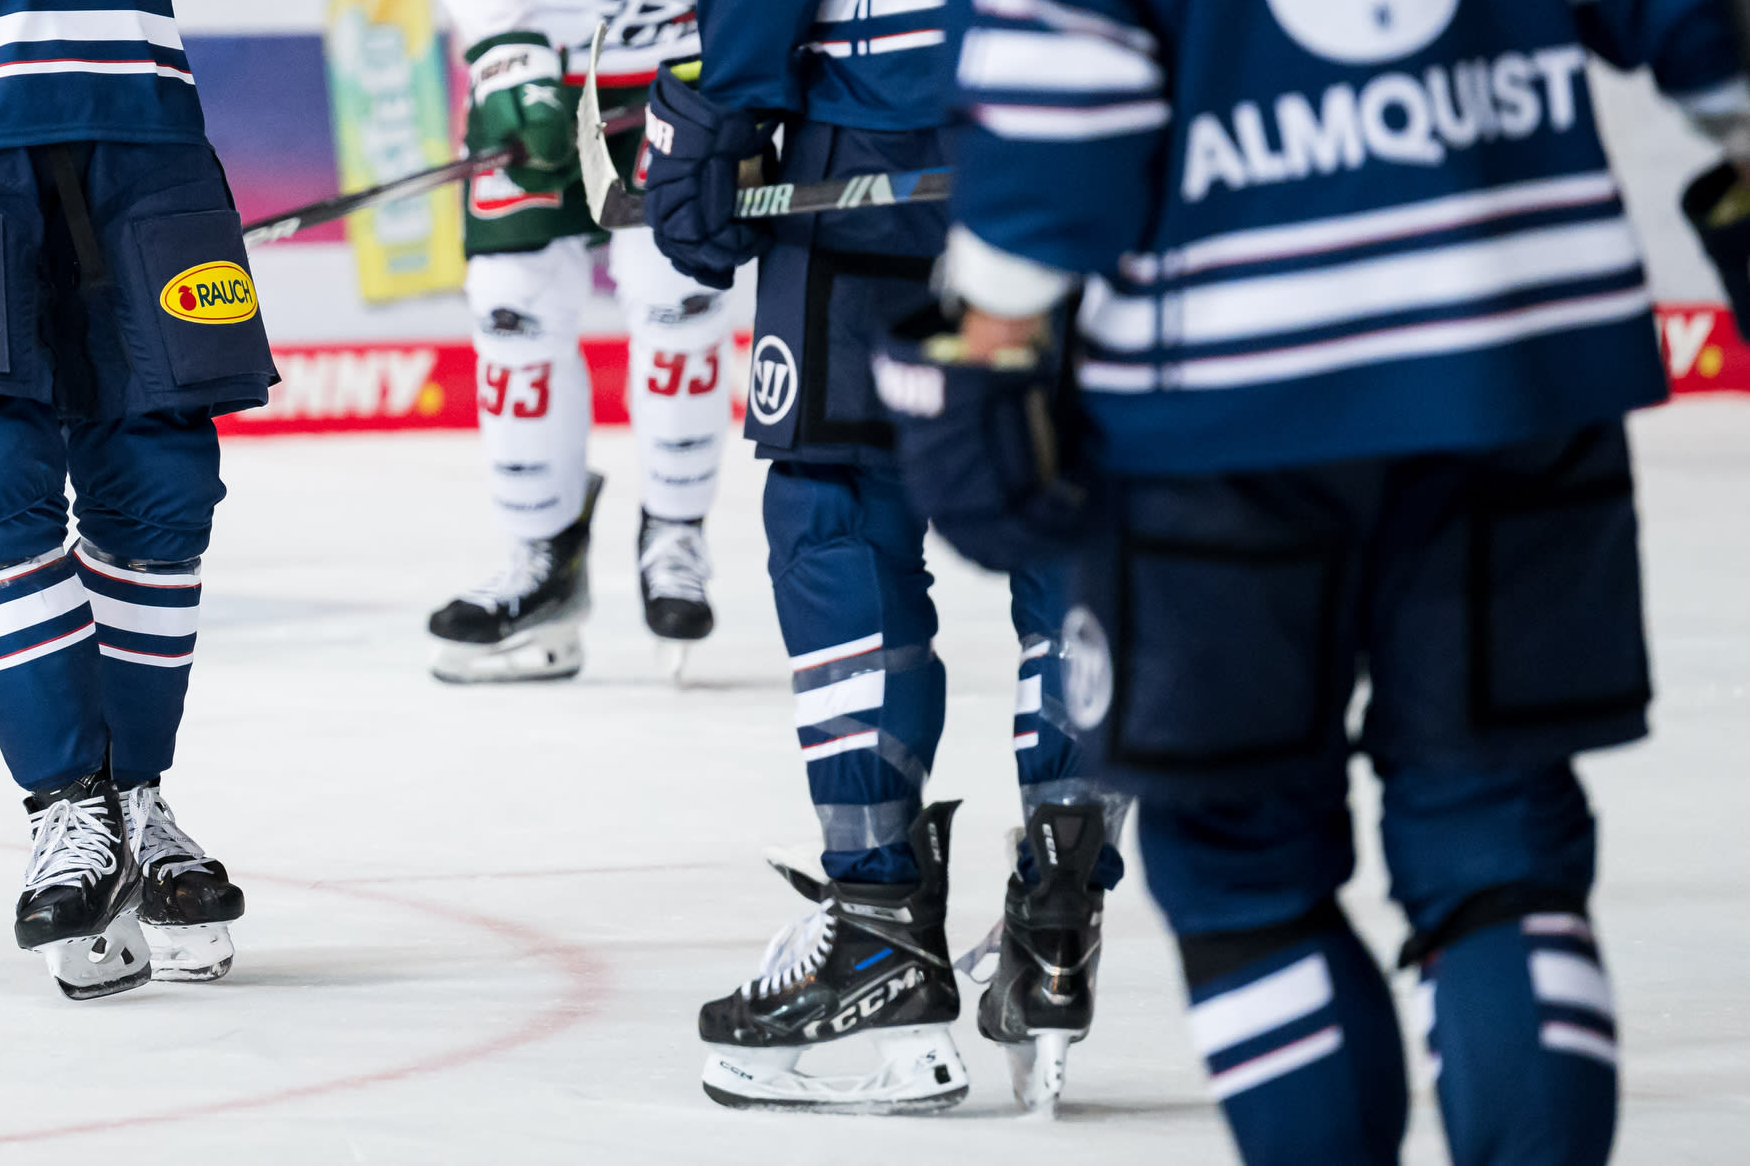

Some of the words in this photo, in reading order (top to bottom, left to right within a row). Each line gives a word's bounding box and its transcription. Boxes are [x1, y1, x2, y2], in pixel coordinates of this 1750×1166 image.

[1181, 42, 1590, 202] ALMQUIST
[195, 278, 253, 308] RAUCH
[831, 966, 918, 1034] CCM
[719, 1059, 755, 1082] CCM
